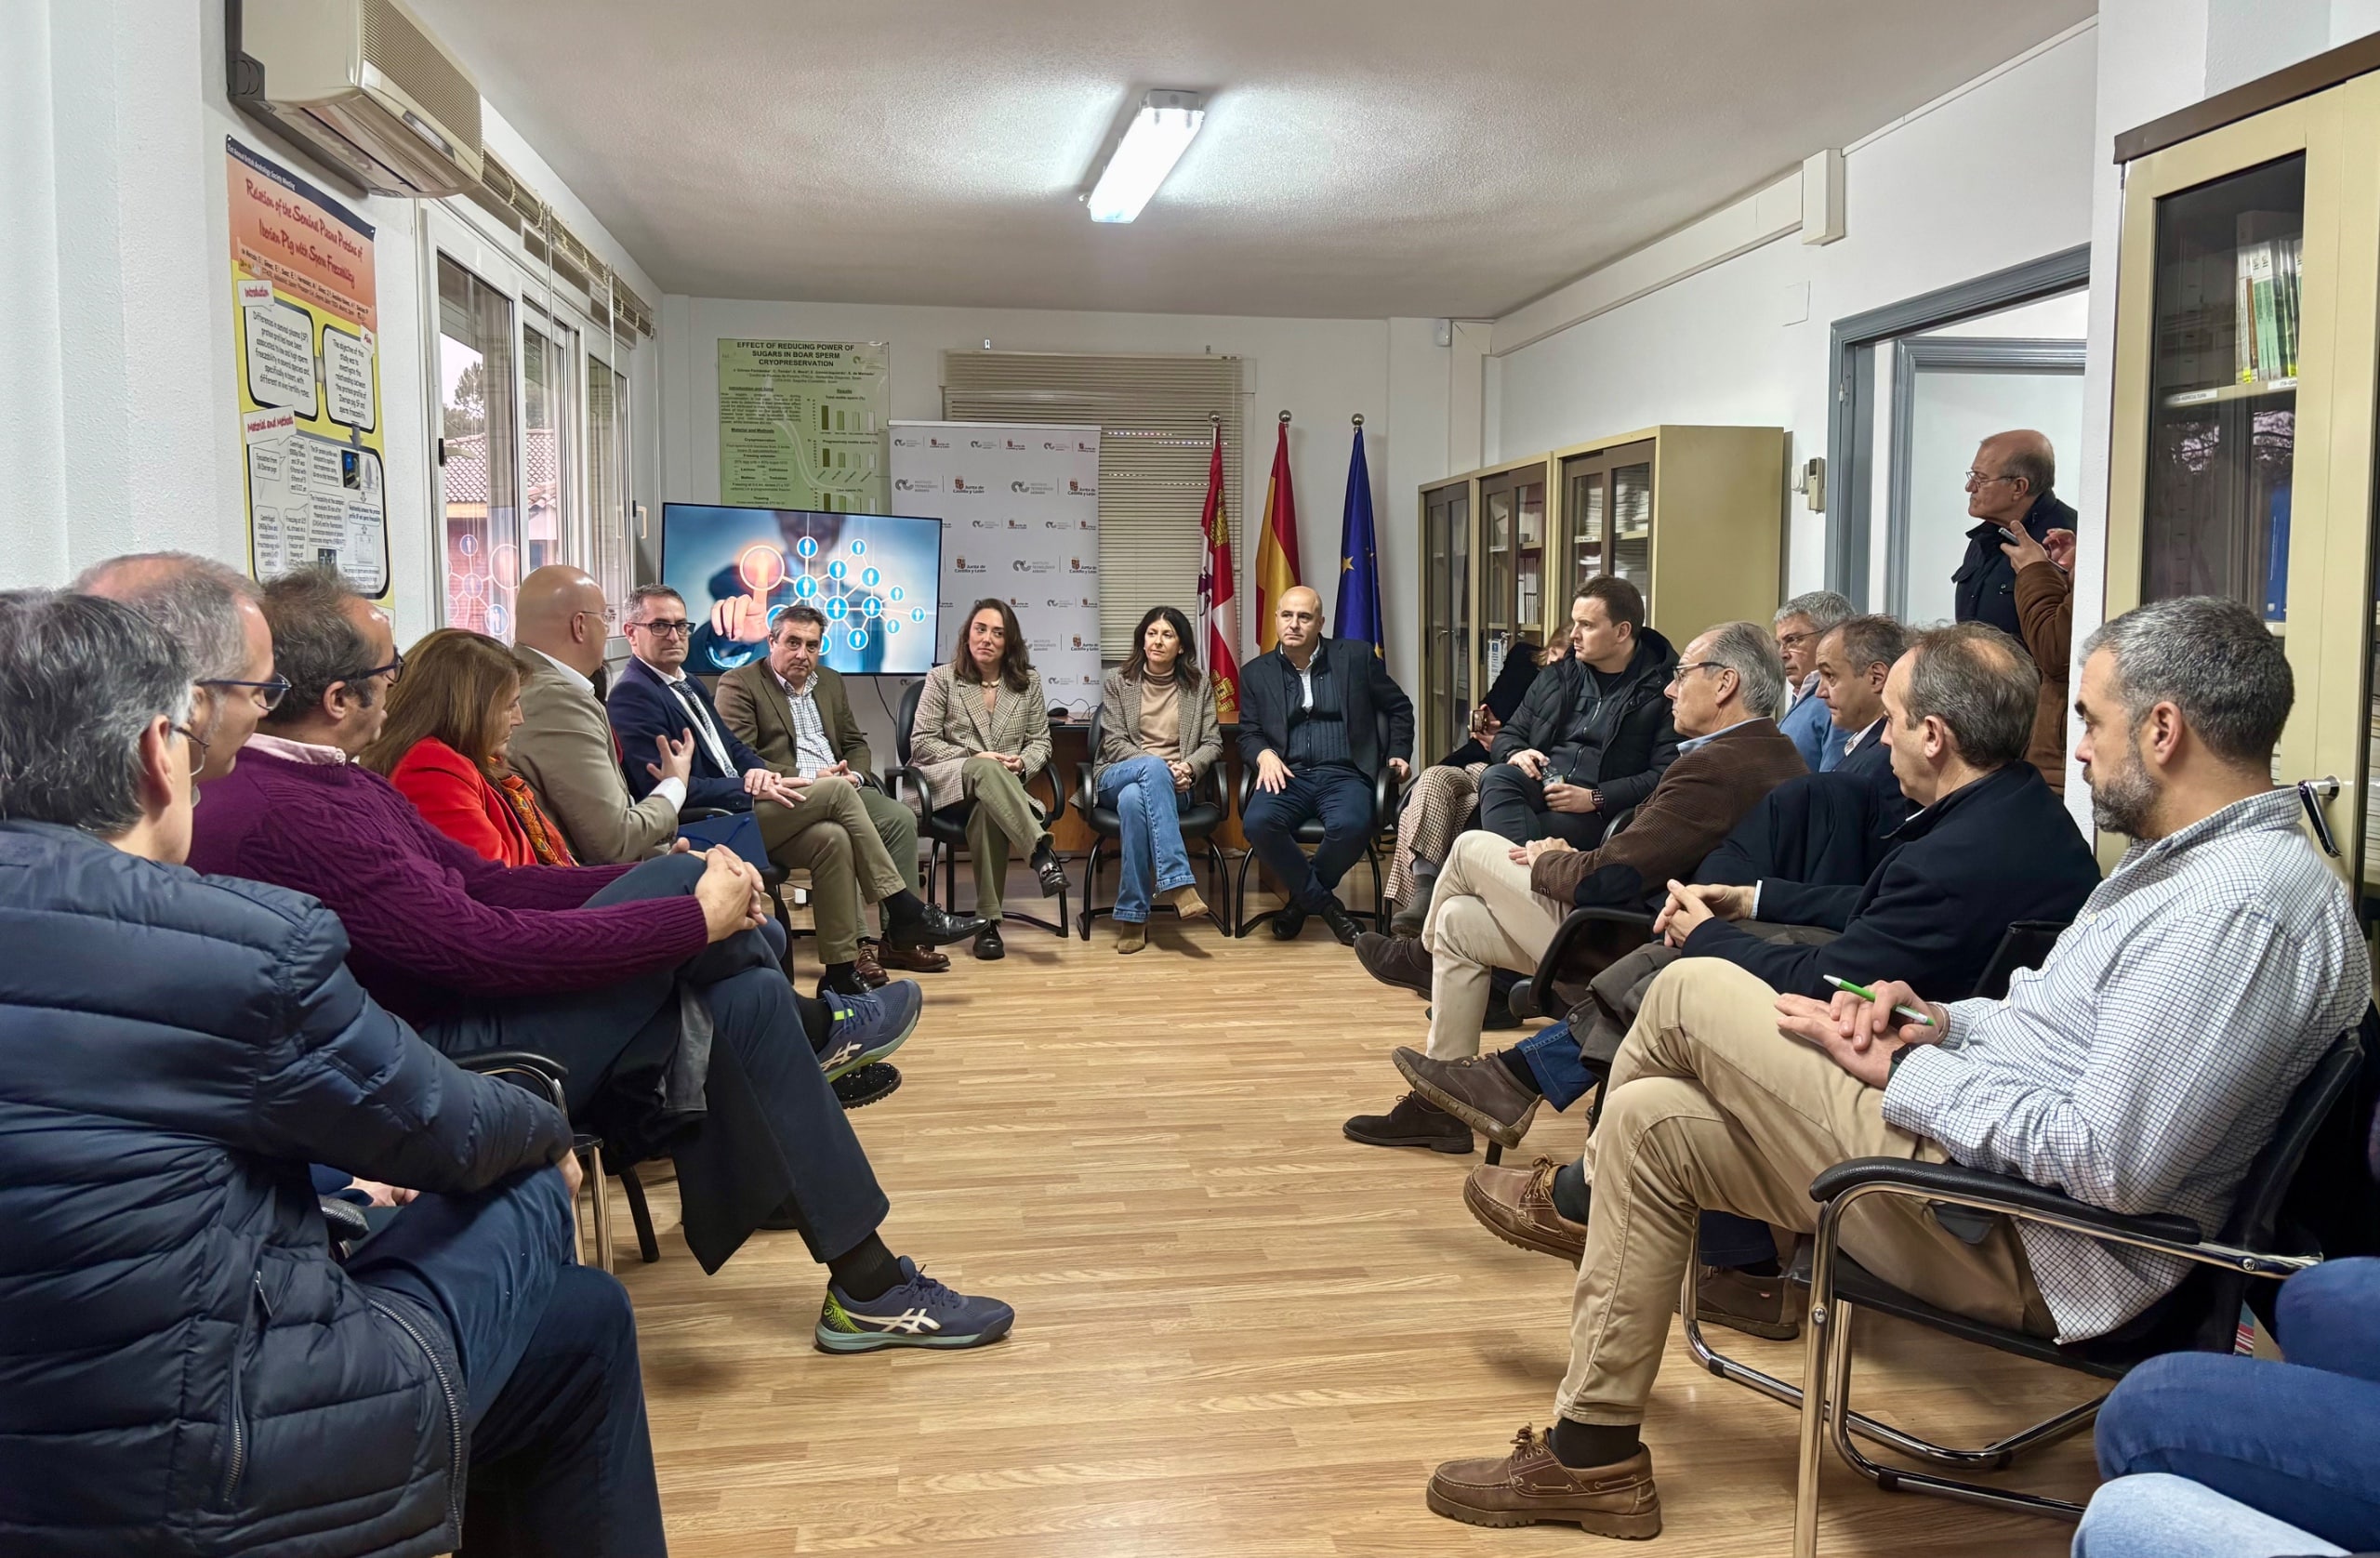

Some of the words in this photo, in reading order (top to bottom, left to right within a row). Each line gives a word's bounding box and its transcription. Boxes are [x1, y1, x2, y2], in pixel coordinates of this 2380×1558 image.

[246, 178, 273, 208] Relation
[275, 197, 282, 218] of
[283, 201, 292, 218] the
[293, 205, 319, 232] Seminal
[281, 230, 294, 256] Pig
[296, 243, 309, 257] with
[310, 245, 326, 268] Sperm
[759, 359, 834, 367] CRYOPRESERVATION
